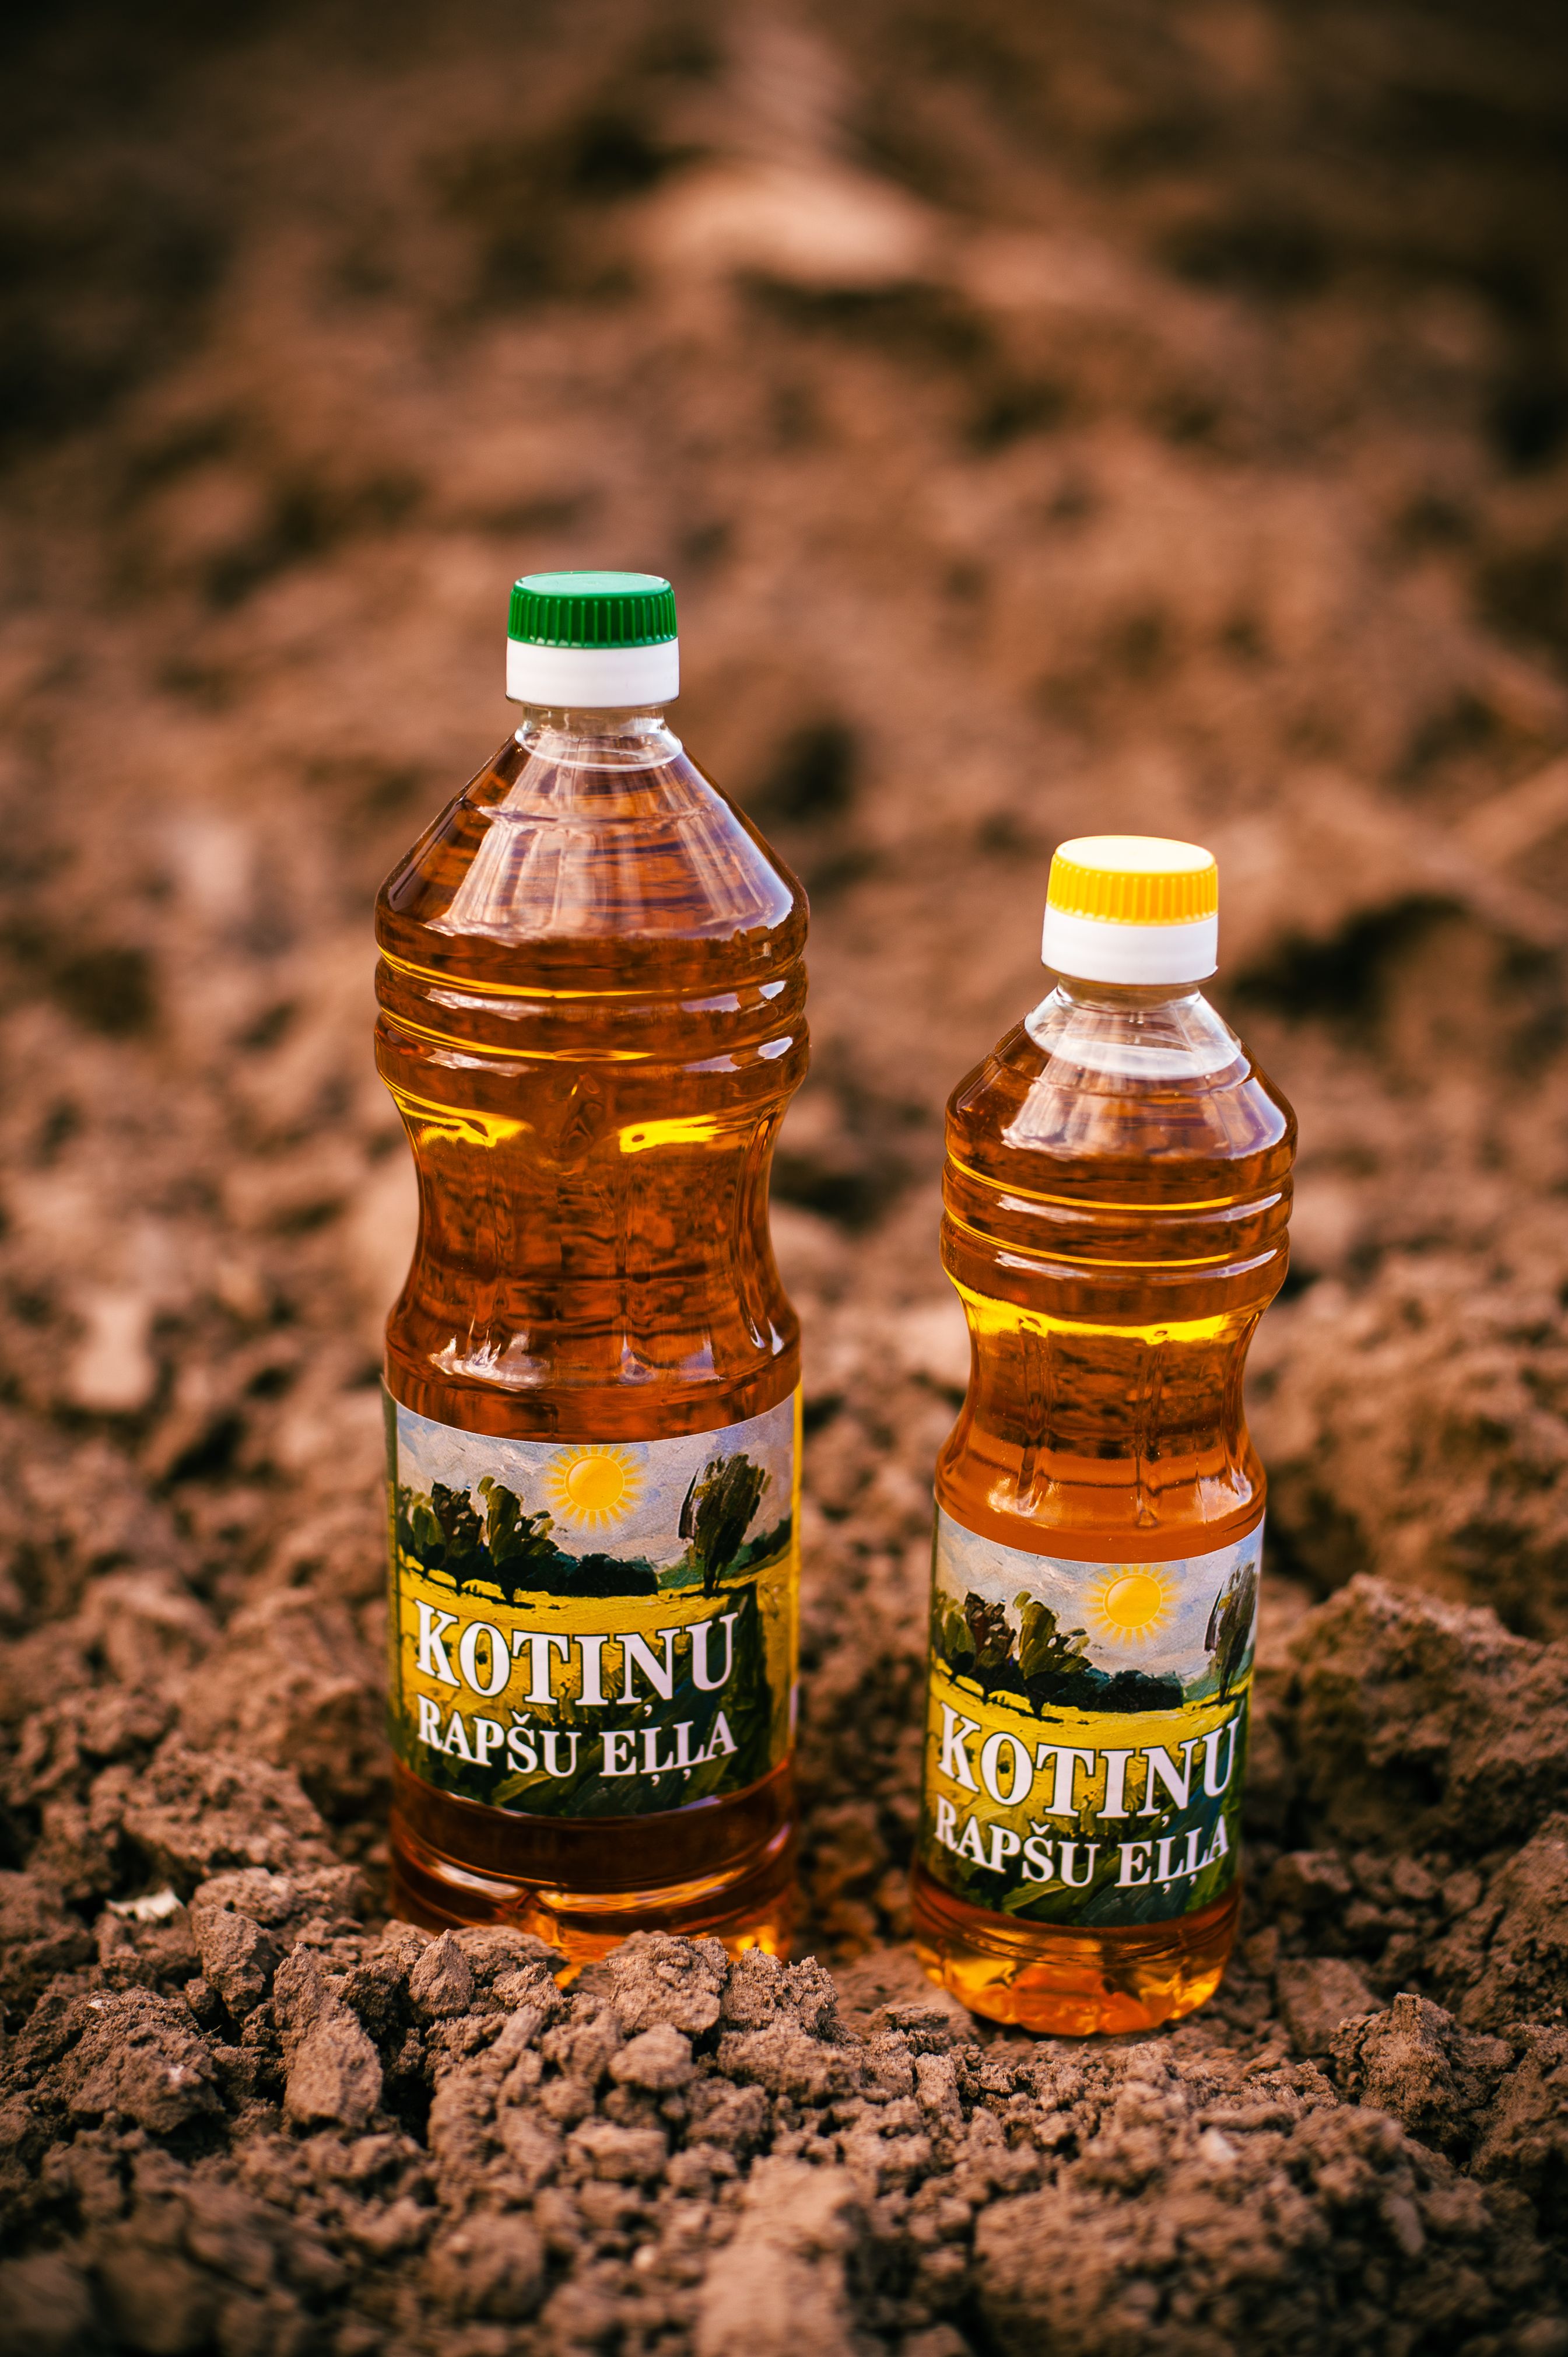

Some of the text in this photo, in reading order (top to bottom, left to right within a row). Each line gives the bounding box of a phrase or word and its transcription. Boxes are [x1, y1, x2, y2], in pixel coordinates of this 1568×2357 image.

[415, 1598, 739, 1718] KOTIŅU
[416, 1694, 738, 1786] RAPŠU EĻĻA
[937, 1701, 1239, 1827] KOTIŅU
[934, 1793, 1229, 1895] RAPŠU EĻĻA
